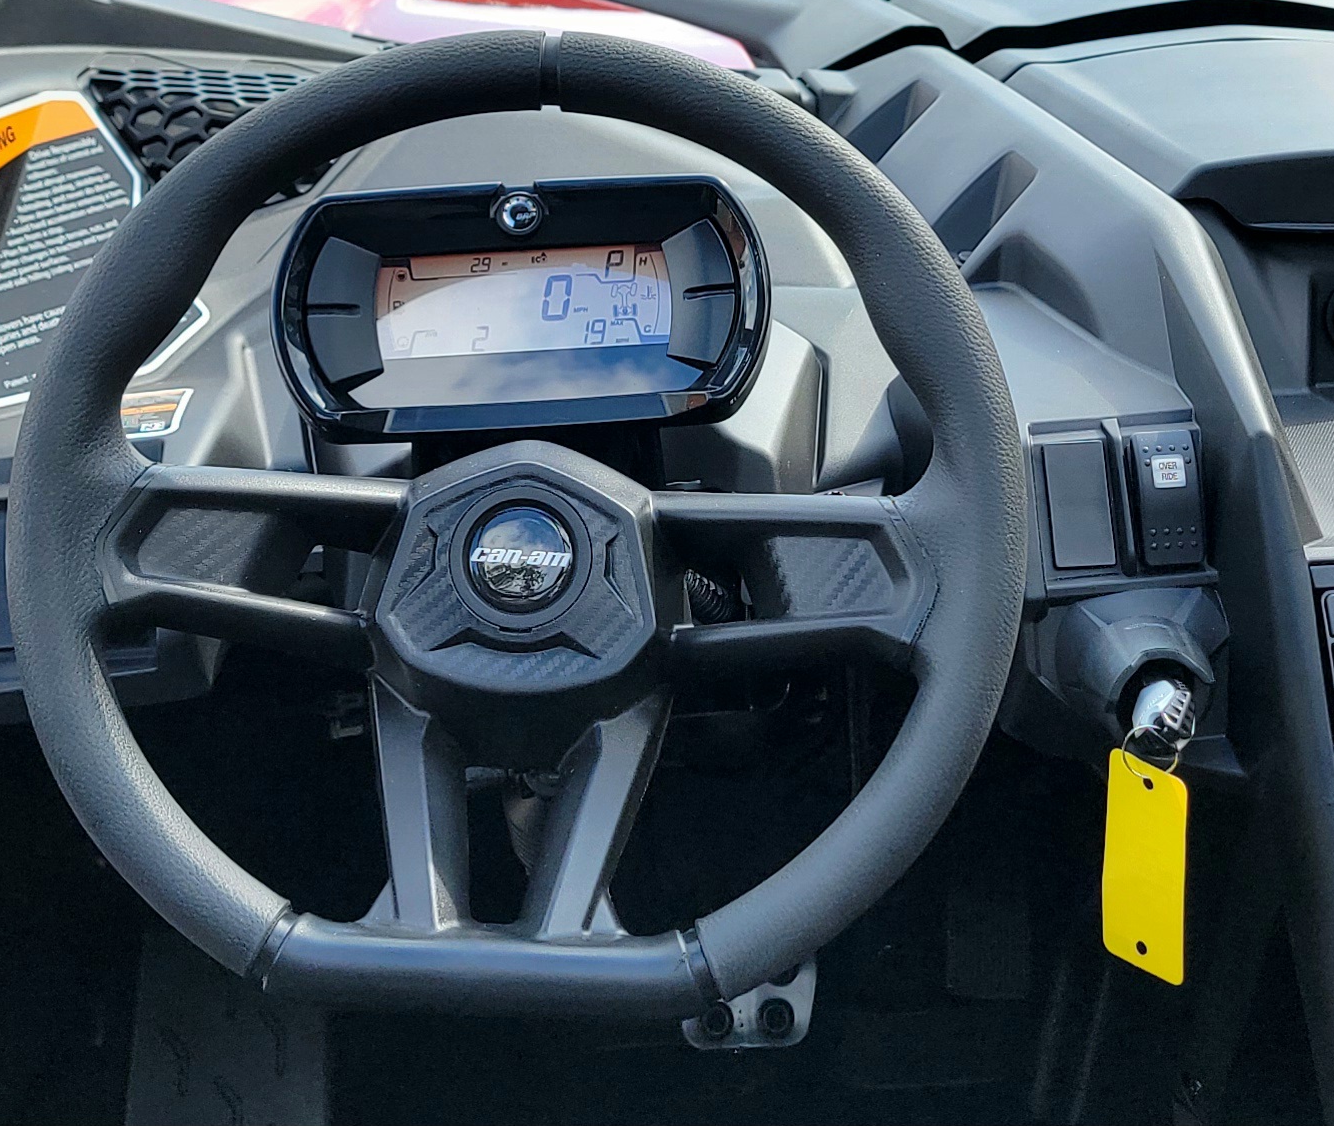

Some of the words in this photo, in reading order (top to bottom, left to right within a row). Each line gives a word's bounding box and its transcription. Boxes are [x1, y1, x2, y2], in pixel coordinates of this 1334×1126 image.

[470, 257, 491, 273] 29
[605, 250, 624, 278] P
[639, 257, 647, 266] H
[542, 274, 572, 321] 0
[584, 319, 607, 344] 19
[643, 325, 652, 333] C
[472, 326, 489, 352] 2
[1159, 462, 1177, 470] OVER
[1161, 473, 1179, 481] RIDE
[471, 547, 571, 568] can-am
